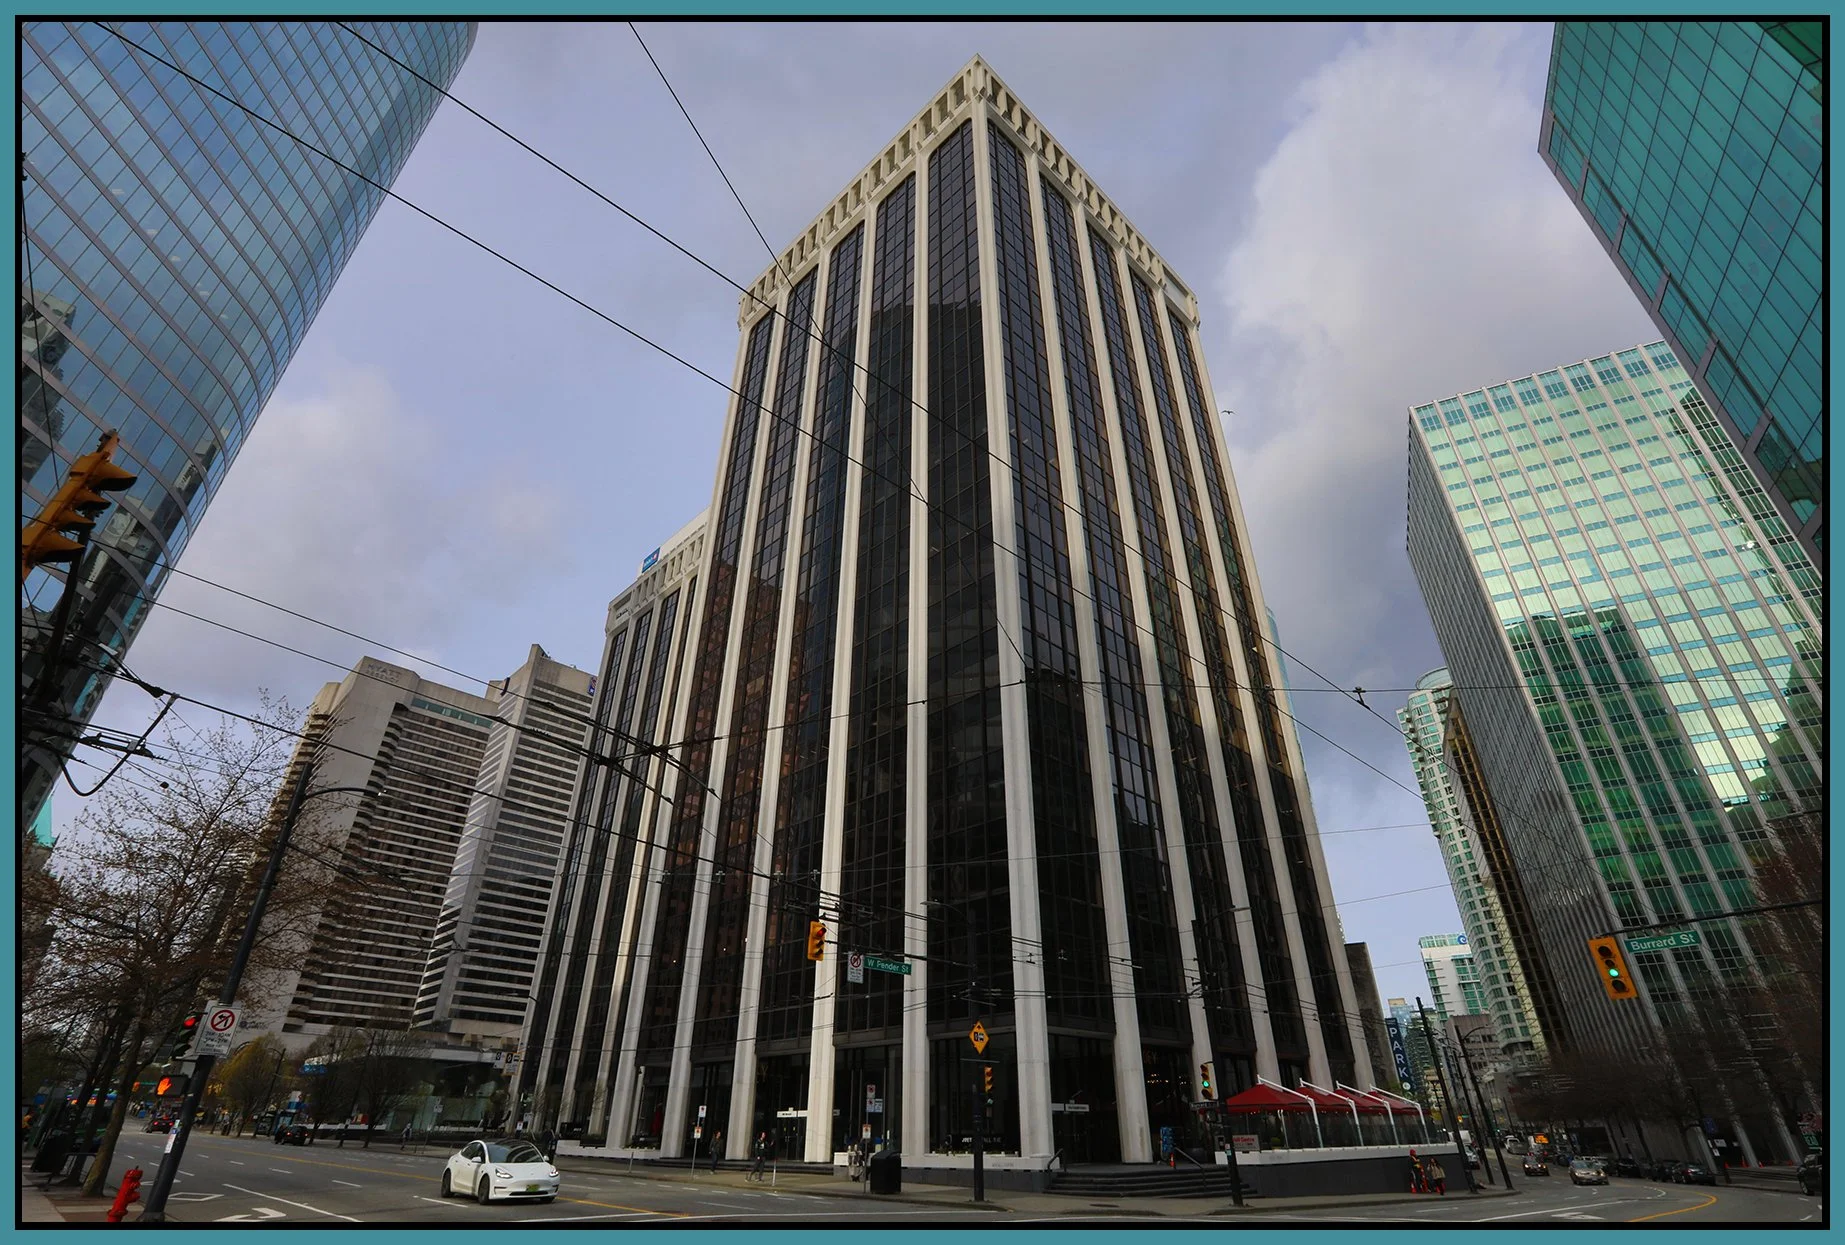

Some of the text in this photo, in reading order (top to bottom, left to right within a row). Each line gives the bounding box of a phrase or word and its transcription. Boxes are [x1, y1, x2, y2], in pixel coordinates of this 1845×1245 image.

[367, 663, 402, 678] HYATT
[1630, 933, 1696, 950] Burrard St
[867, 959, 909, 973] W Pender St
[1389, 1027, 1409, 1077] PARK
